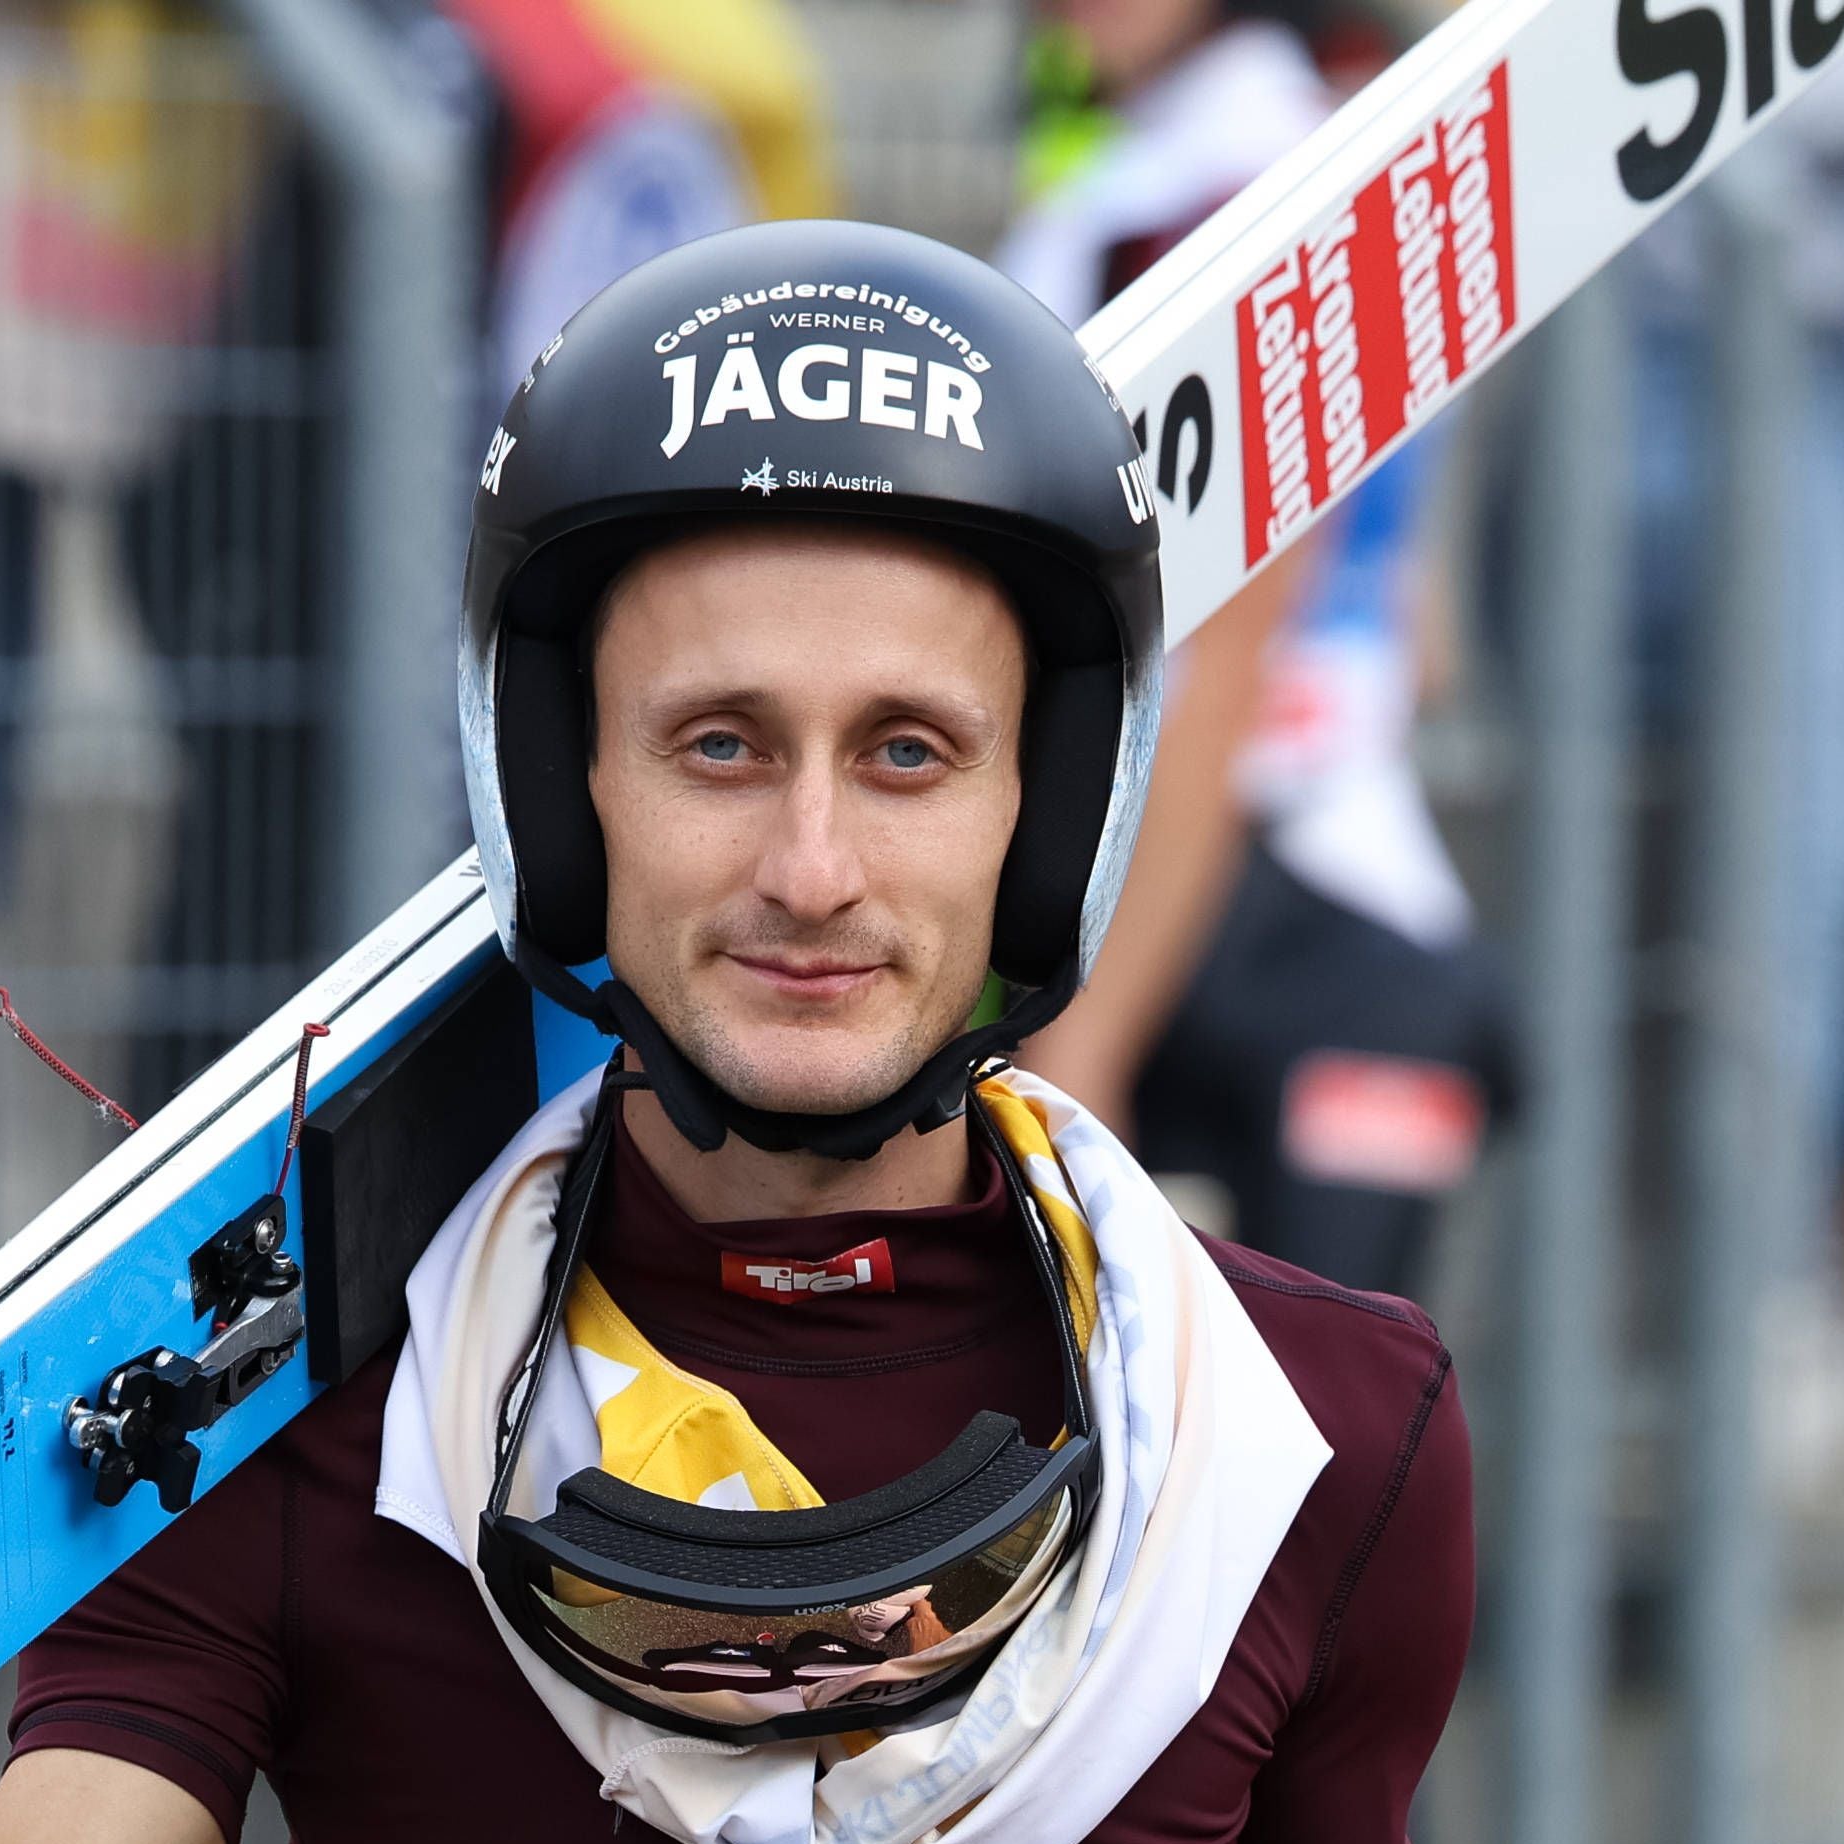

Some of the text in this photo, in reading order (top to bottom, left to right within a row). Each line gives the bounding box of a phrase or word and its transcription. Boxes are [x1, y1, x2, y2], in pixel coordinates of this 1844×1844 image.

[1389, 120, 1450, 428] Zeitung
[1444, 78, 1504, 369] Kronen
[654, 280, 993, 374] Gebäudereinigung
[768, 312, 886, 334] WERNER
[1306, 205, 1368, 497] Kronen
[659, 331, 985, 460] JÄGER
[1251, 255, 1314, 554] Zeitung
[786, 470, 893, 494] Ski Austria
[745, 1257, 872, 1293] Tirol
